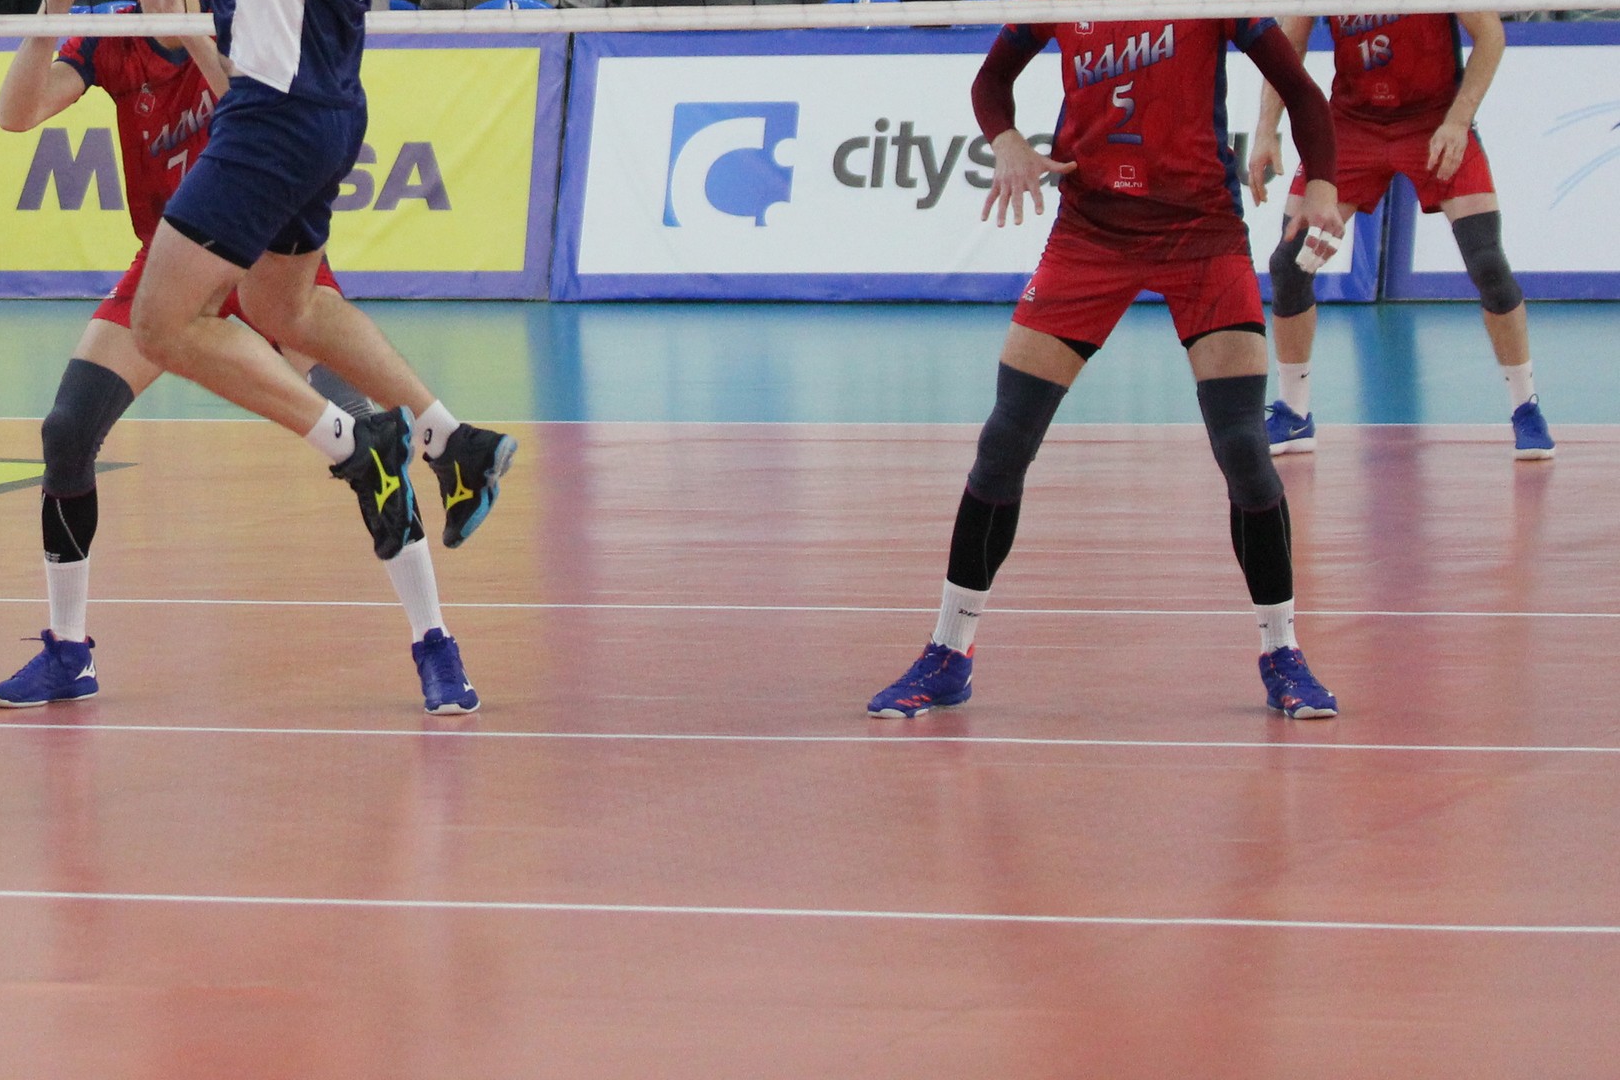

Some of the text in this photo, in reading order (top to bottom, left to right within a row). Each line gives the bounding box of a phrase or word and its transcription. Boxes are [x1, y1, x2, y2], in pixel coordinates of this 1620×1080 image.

[1073, 23, 1177, 89] КАМА
[1357, 34, 1393, 71] 18
[143, 89, 216, 158] АМА
[1112, 80, 1136, 129] 5
